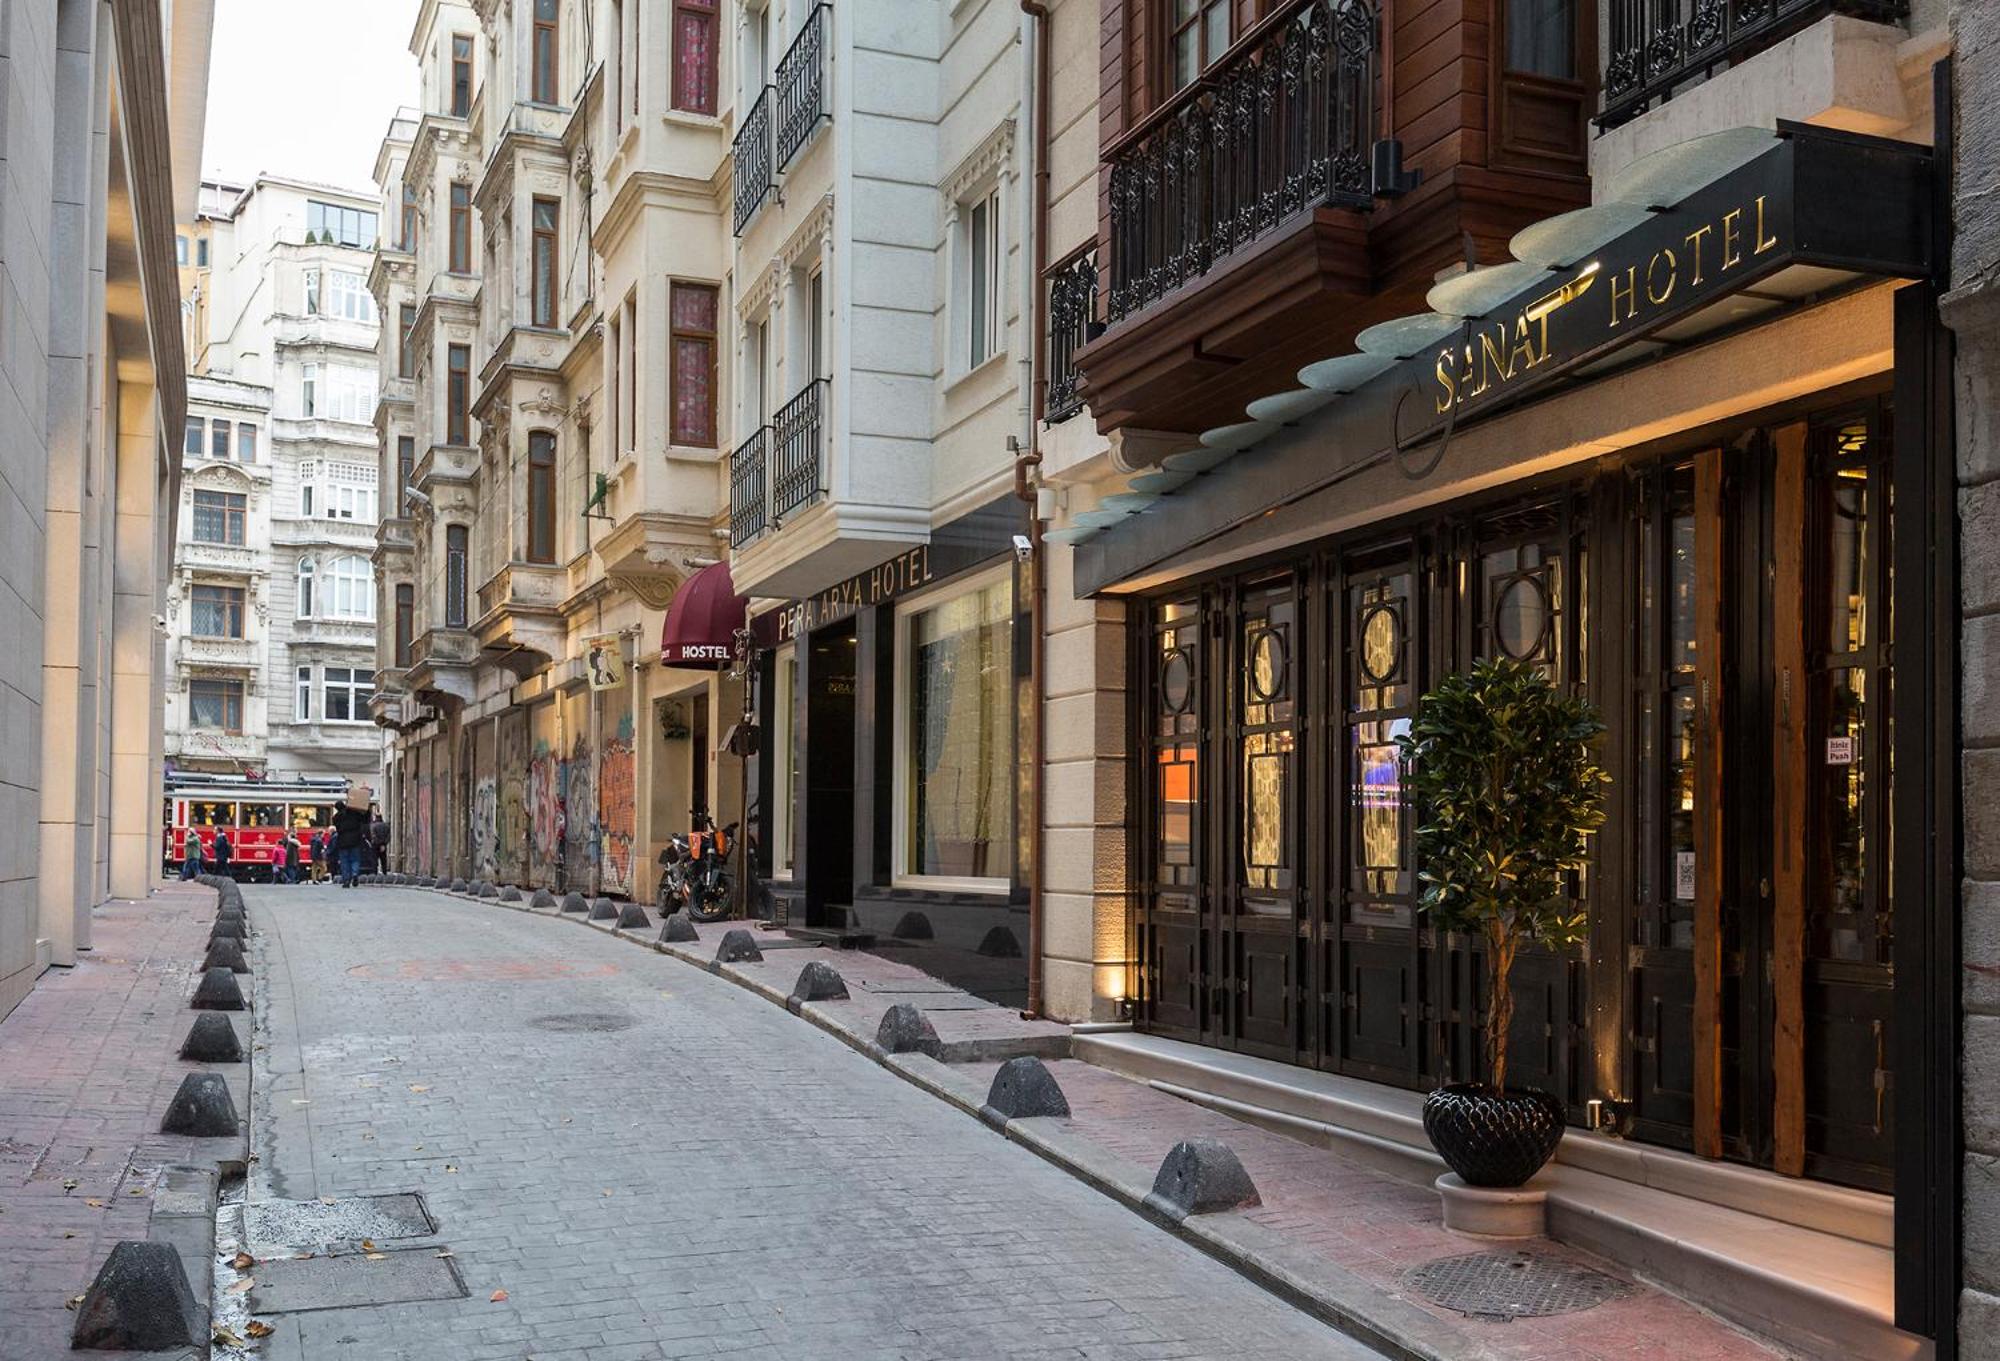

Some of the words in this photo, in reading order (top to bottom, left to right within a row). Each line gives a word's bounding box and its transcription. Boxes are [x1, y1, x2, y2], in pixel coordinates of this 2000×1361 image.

[1437, 264, 1596, 414] SANAT
[1609, 195, 1777, 328] HOTEL
[778, 599, 814, 641] PERA
[820, 577, 863, 625] ARYA
[871, 545, 933, 603] HOTEL
[682, 645, 731, 659] HOSTEL
